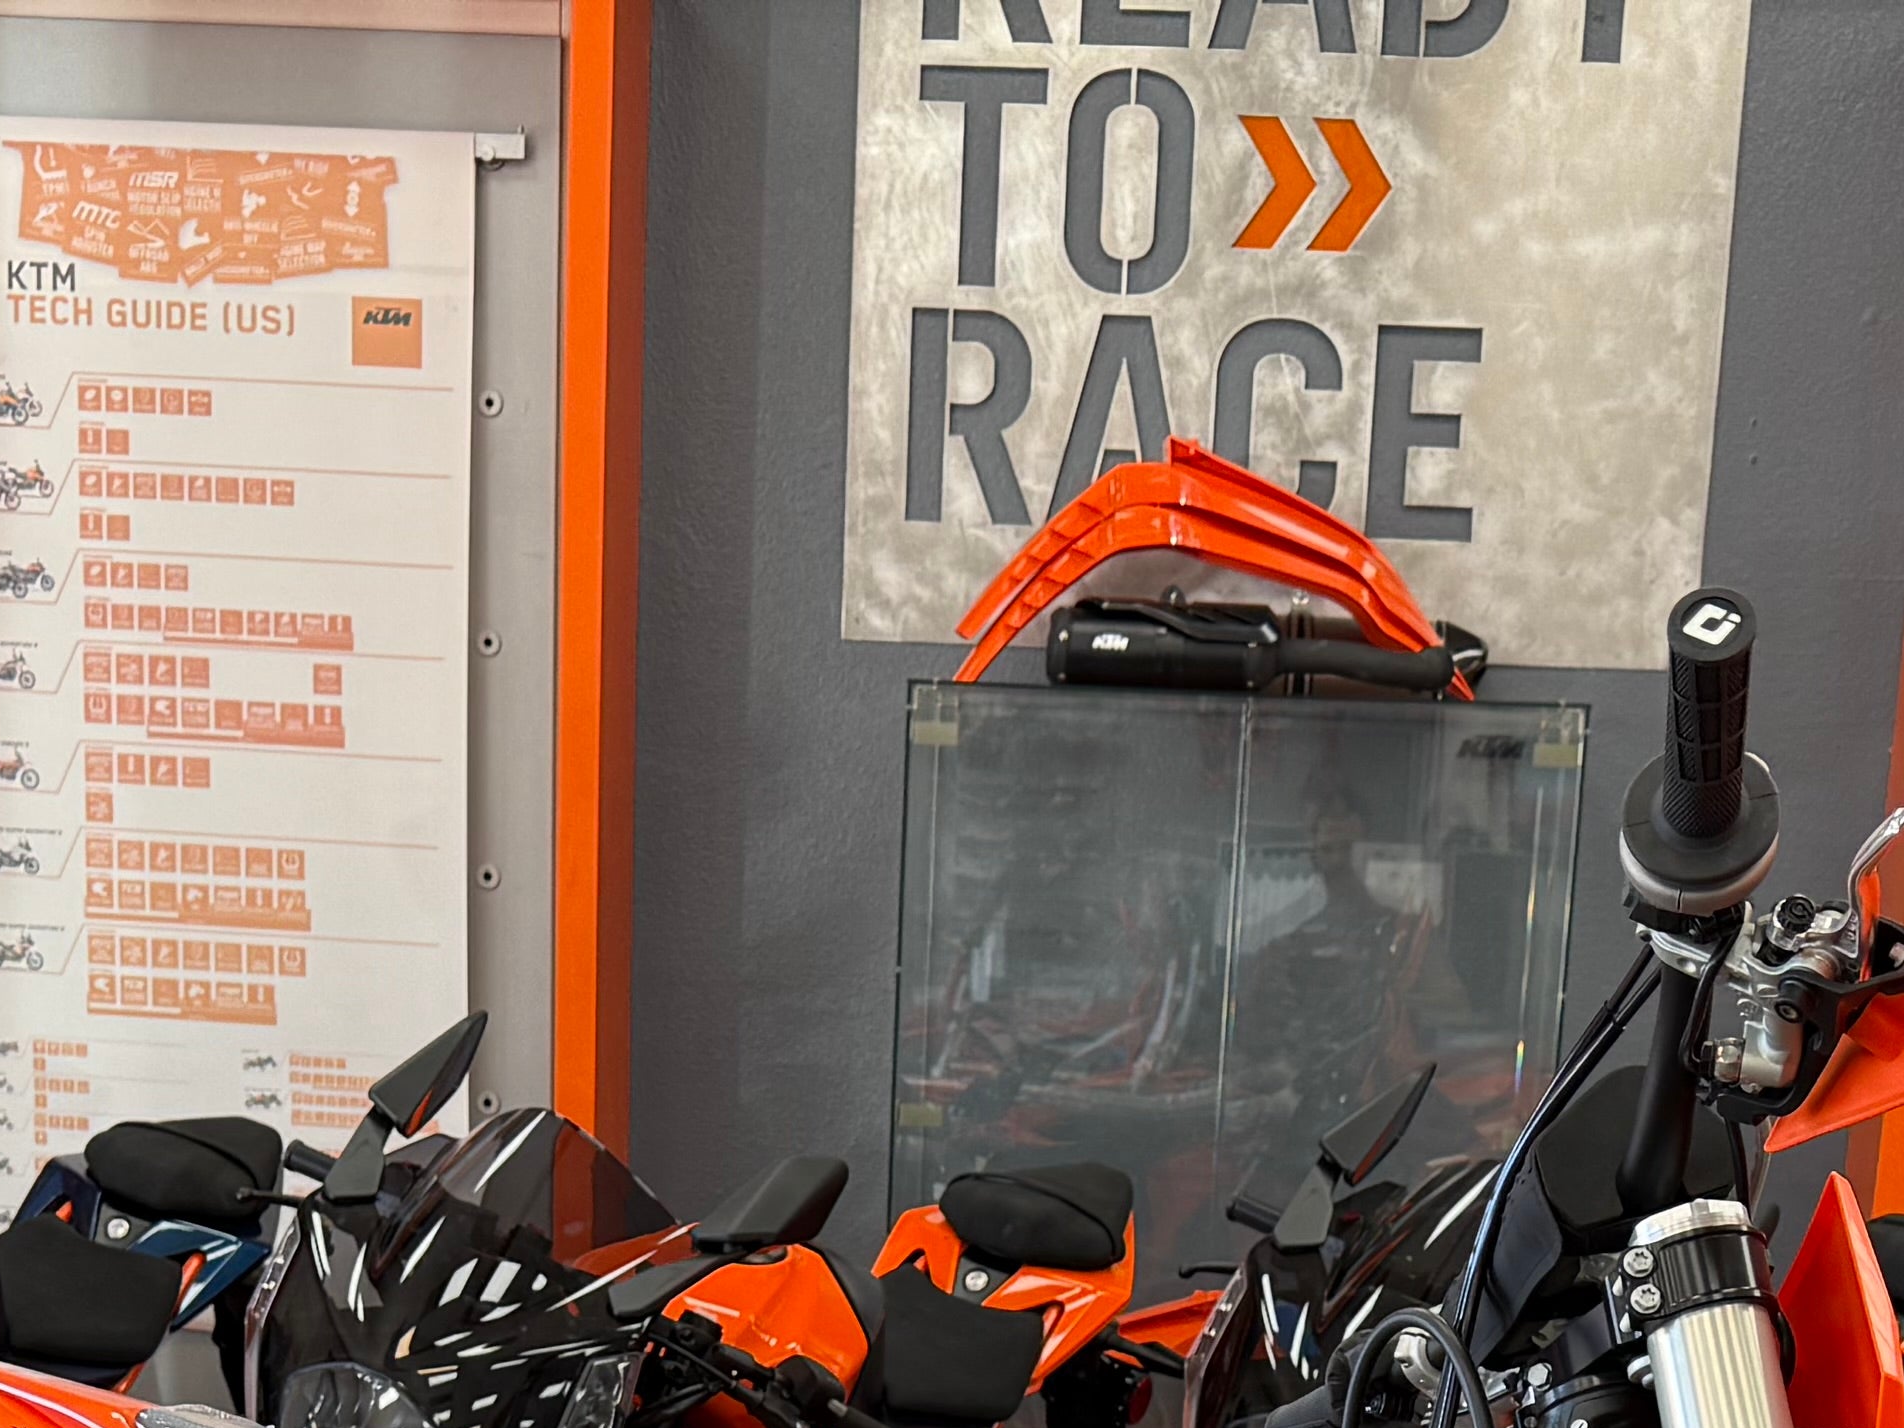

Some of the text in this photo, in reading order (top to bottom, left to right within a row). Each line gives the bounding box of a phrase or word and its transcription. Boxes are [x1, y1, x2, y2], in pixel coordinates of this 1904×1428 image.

[919, 65, 1196, 296] TO
[7, 260, 76, 292] KTM
[7, 294, 296, 337] TECH GUIDE (US)
[363, 306, 413, 327] KTM
[905, 306, 1484, 544] RACE
[1092, 632, 1130, 653] KTM
[1456, 734, 1526, 760] KTM
